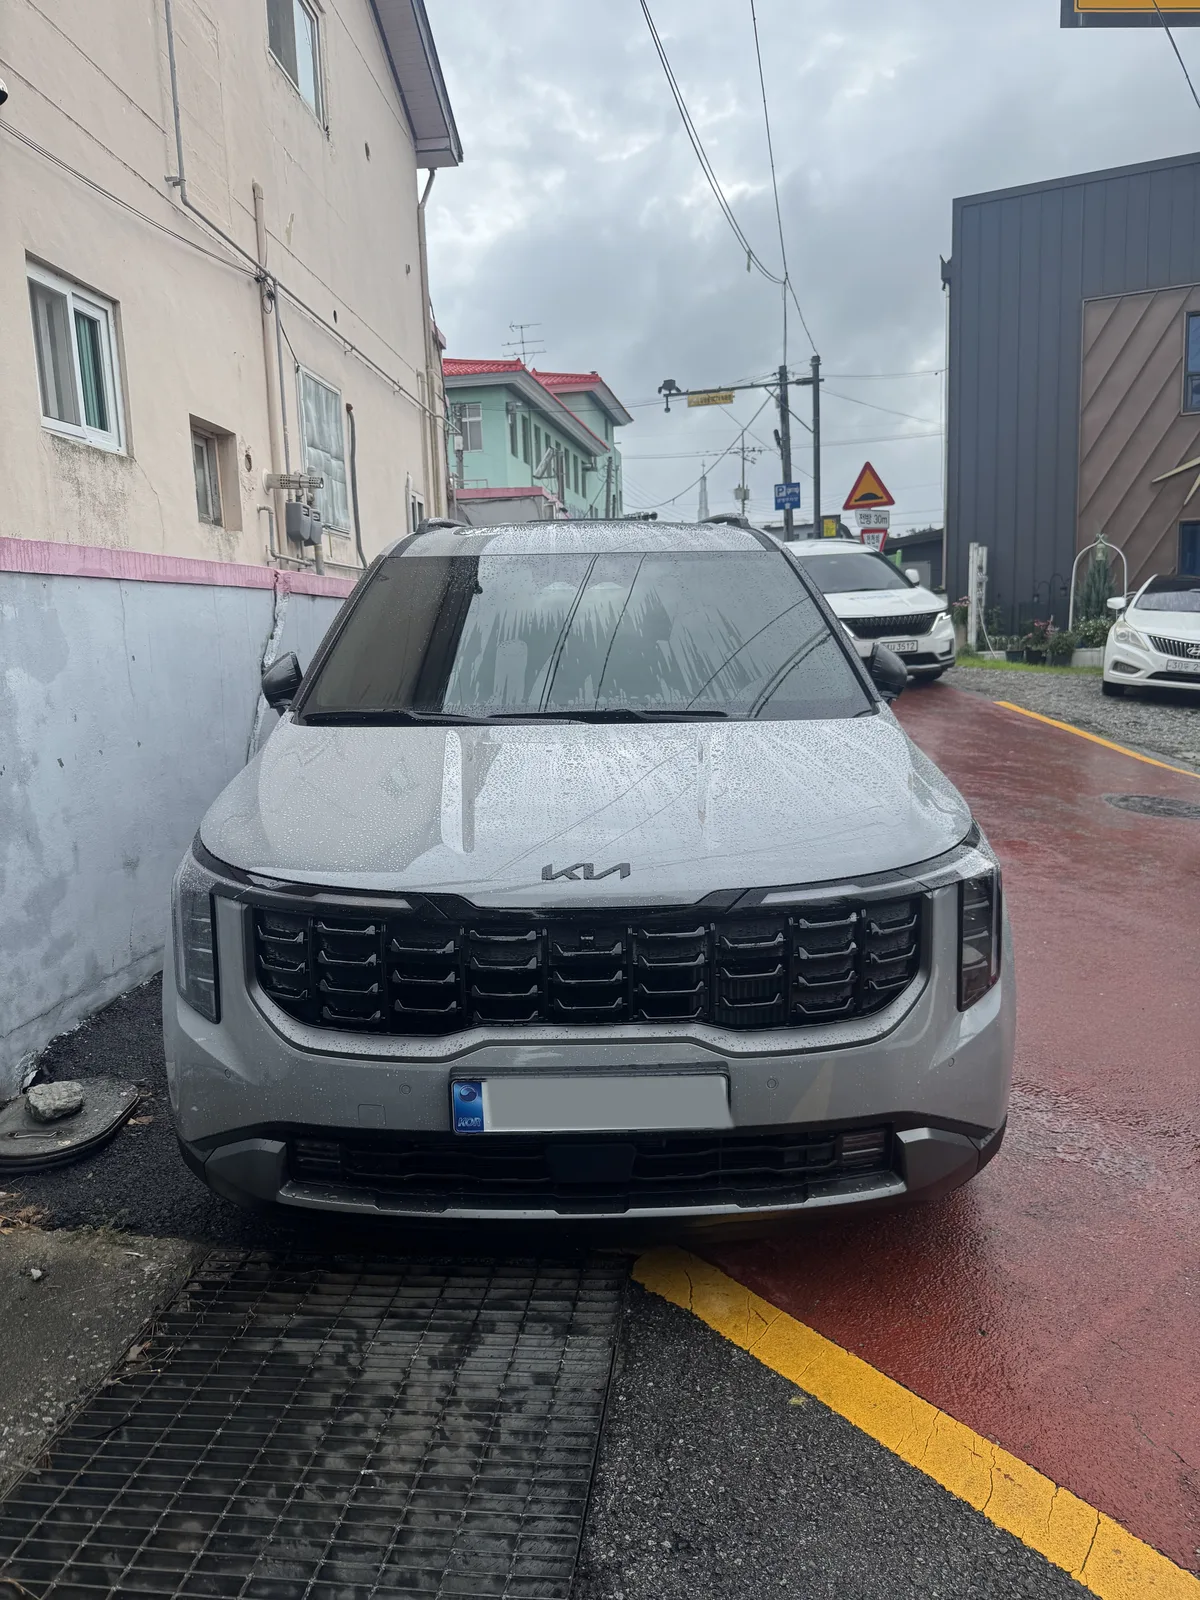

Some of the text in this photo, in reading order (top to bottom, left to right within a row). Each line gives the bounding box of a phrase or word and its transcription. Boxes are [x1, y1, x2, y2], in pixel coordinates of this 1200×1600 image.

[859, 513, 888, 525] 전방 30m
[896, 642, 915, 651] 3512
[541, 863, 631, 880] KIA
[458, 1117, 481, 1127] KOR
